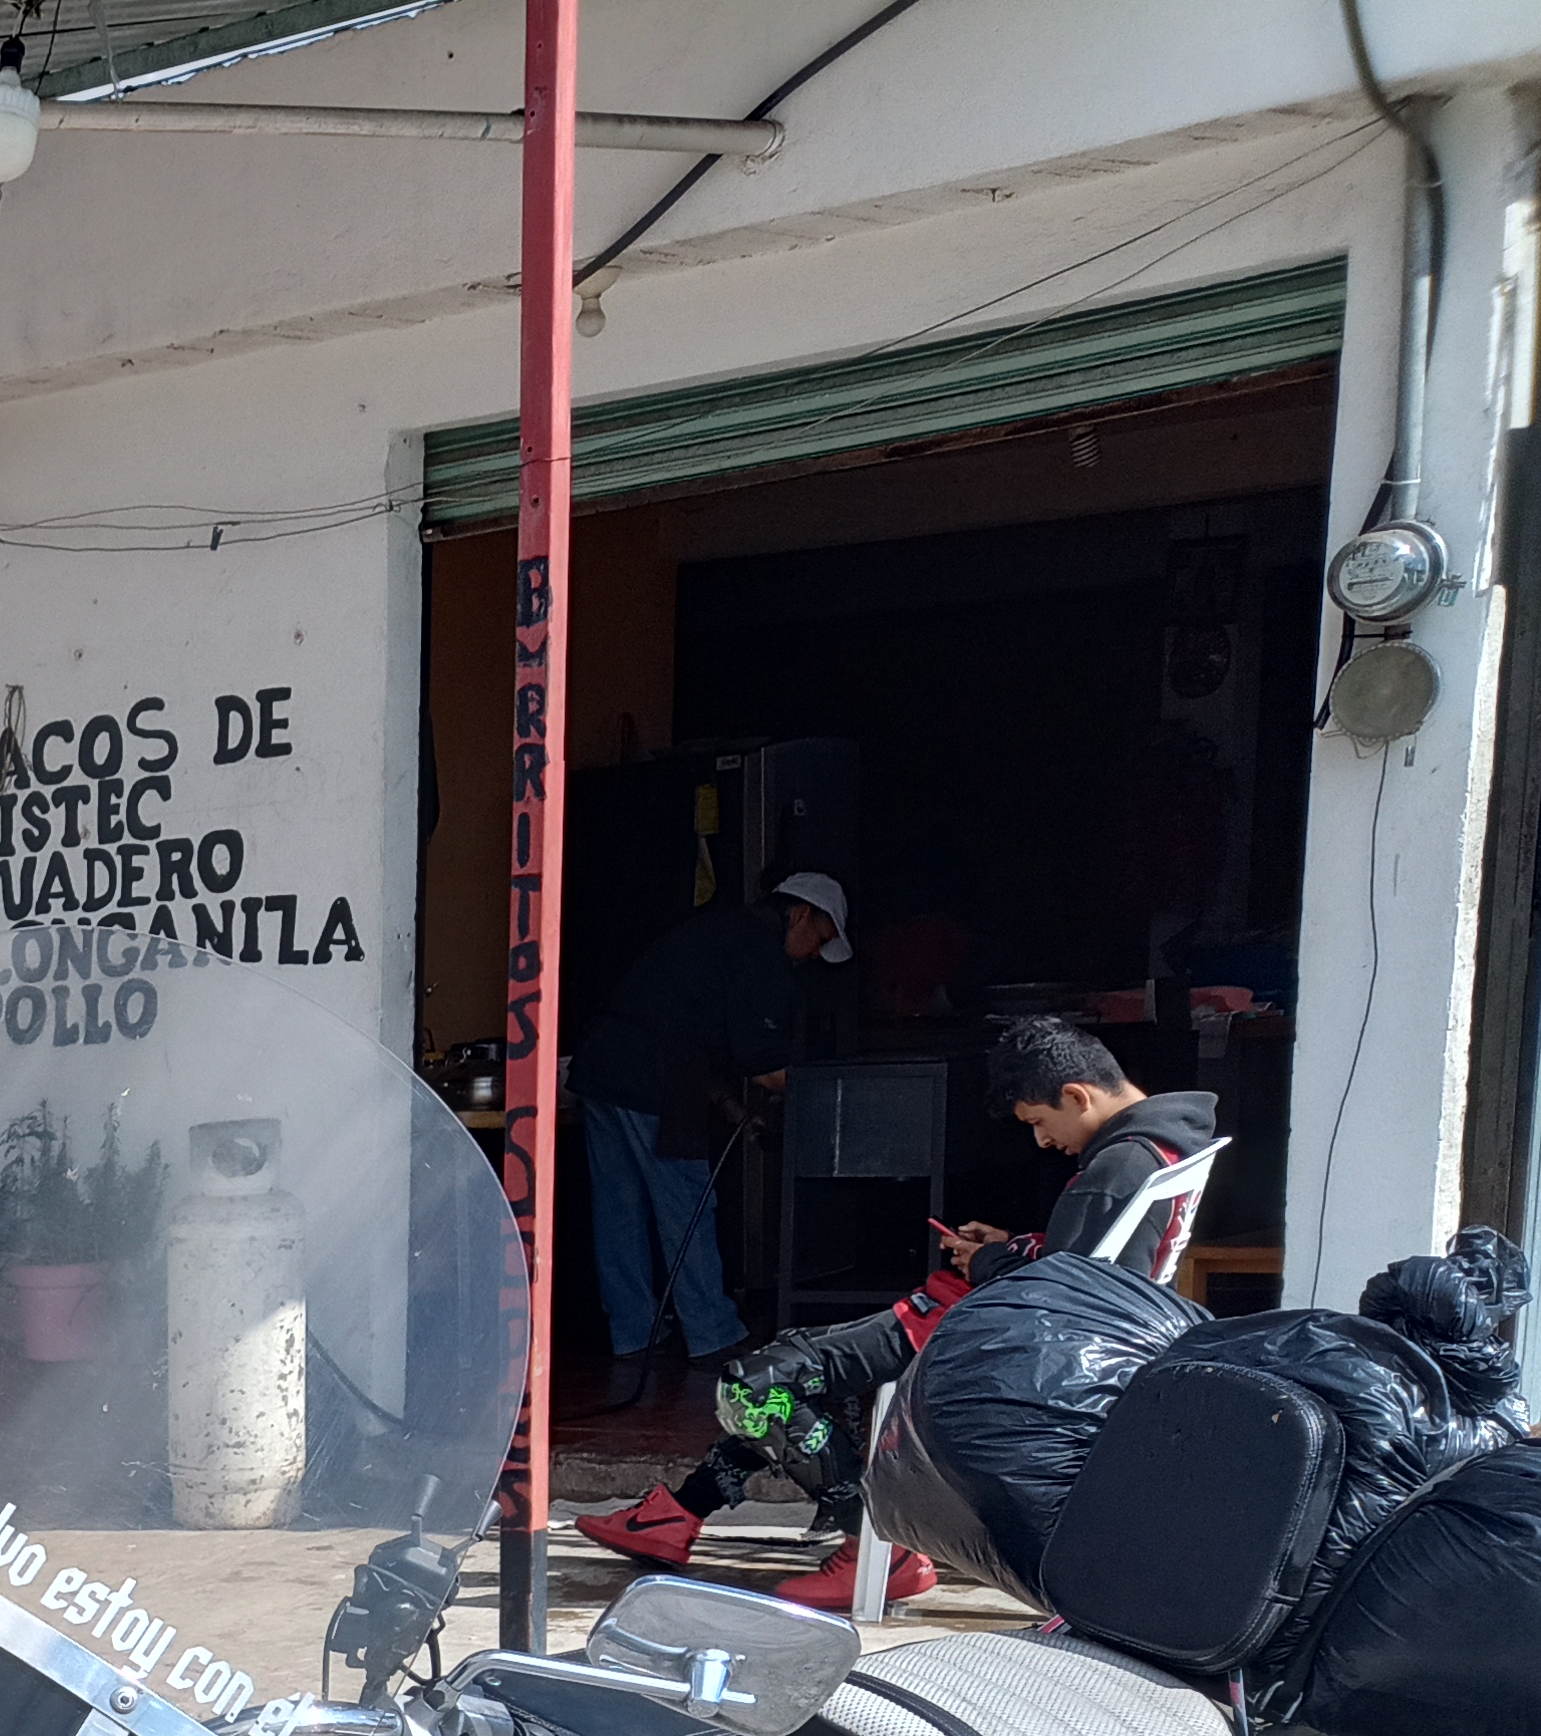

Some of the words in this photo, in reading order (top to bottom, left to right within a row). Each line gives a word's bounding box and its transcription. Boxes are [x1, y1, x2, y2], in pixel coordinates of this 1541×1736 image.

[214, 687, 293, 766] DE
[40, 1578, 177, 1682] estoy
[166, 1644, 255, 1725] con
